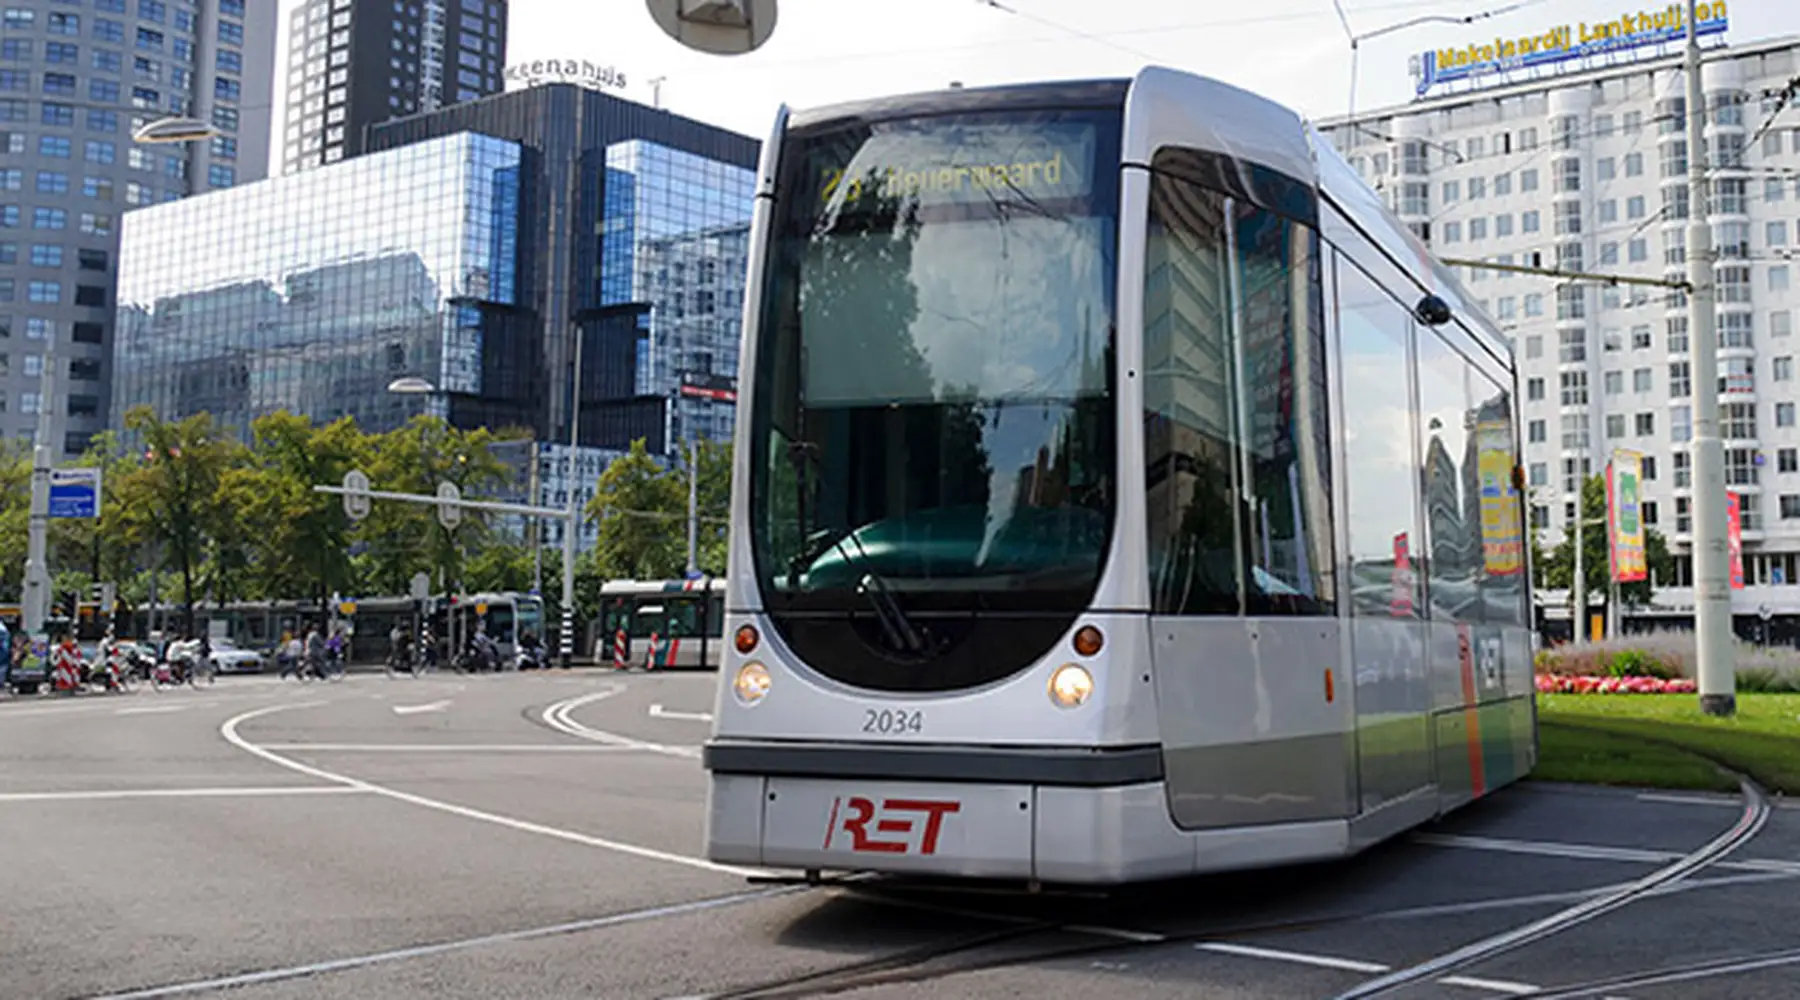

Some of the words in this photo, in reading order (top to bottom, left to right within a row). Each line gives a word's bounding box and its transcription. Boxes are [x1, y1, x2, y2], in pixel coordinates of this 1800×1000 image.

[1436, 25, 1571, 69] Makelaardij
[1579, 0, 1727, 43] Lankhuijen
[862, 709, 923, 734] 2034
[842, 796, 961, 855] RET
